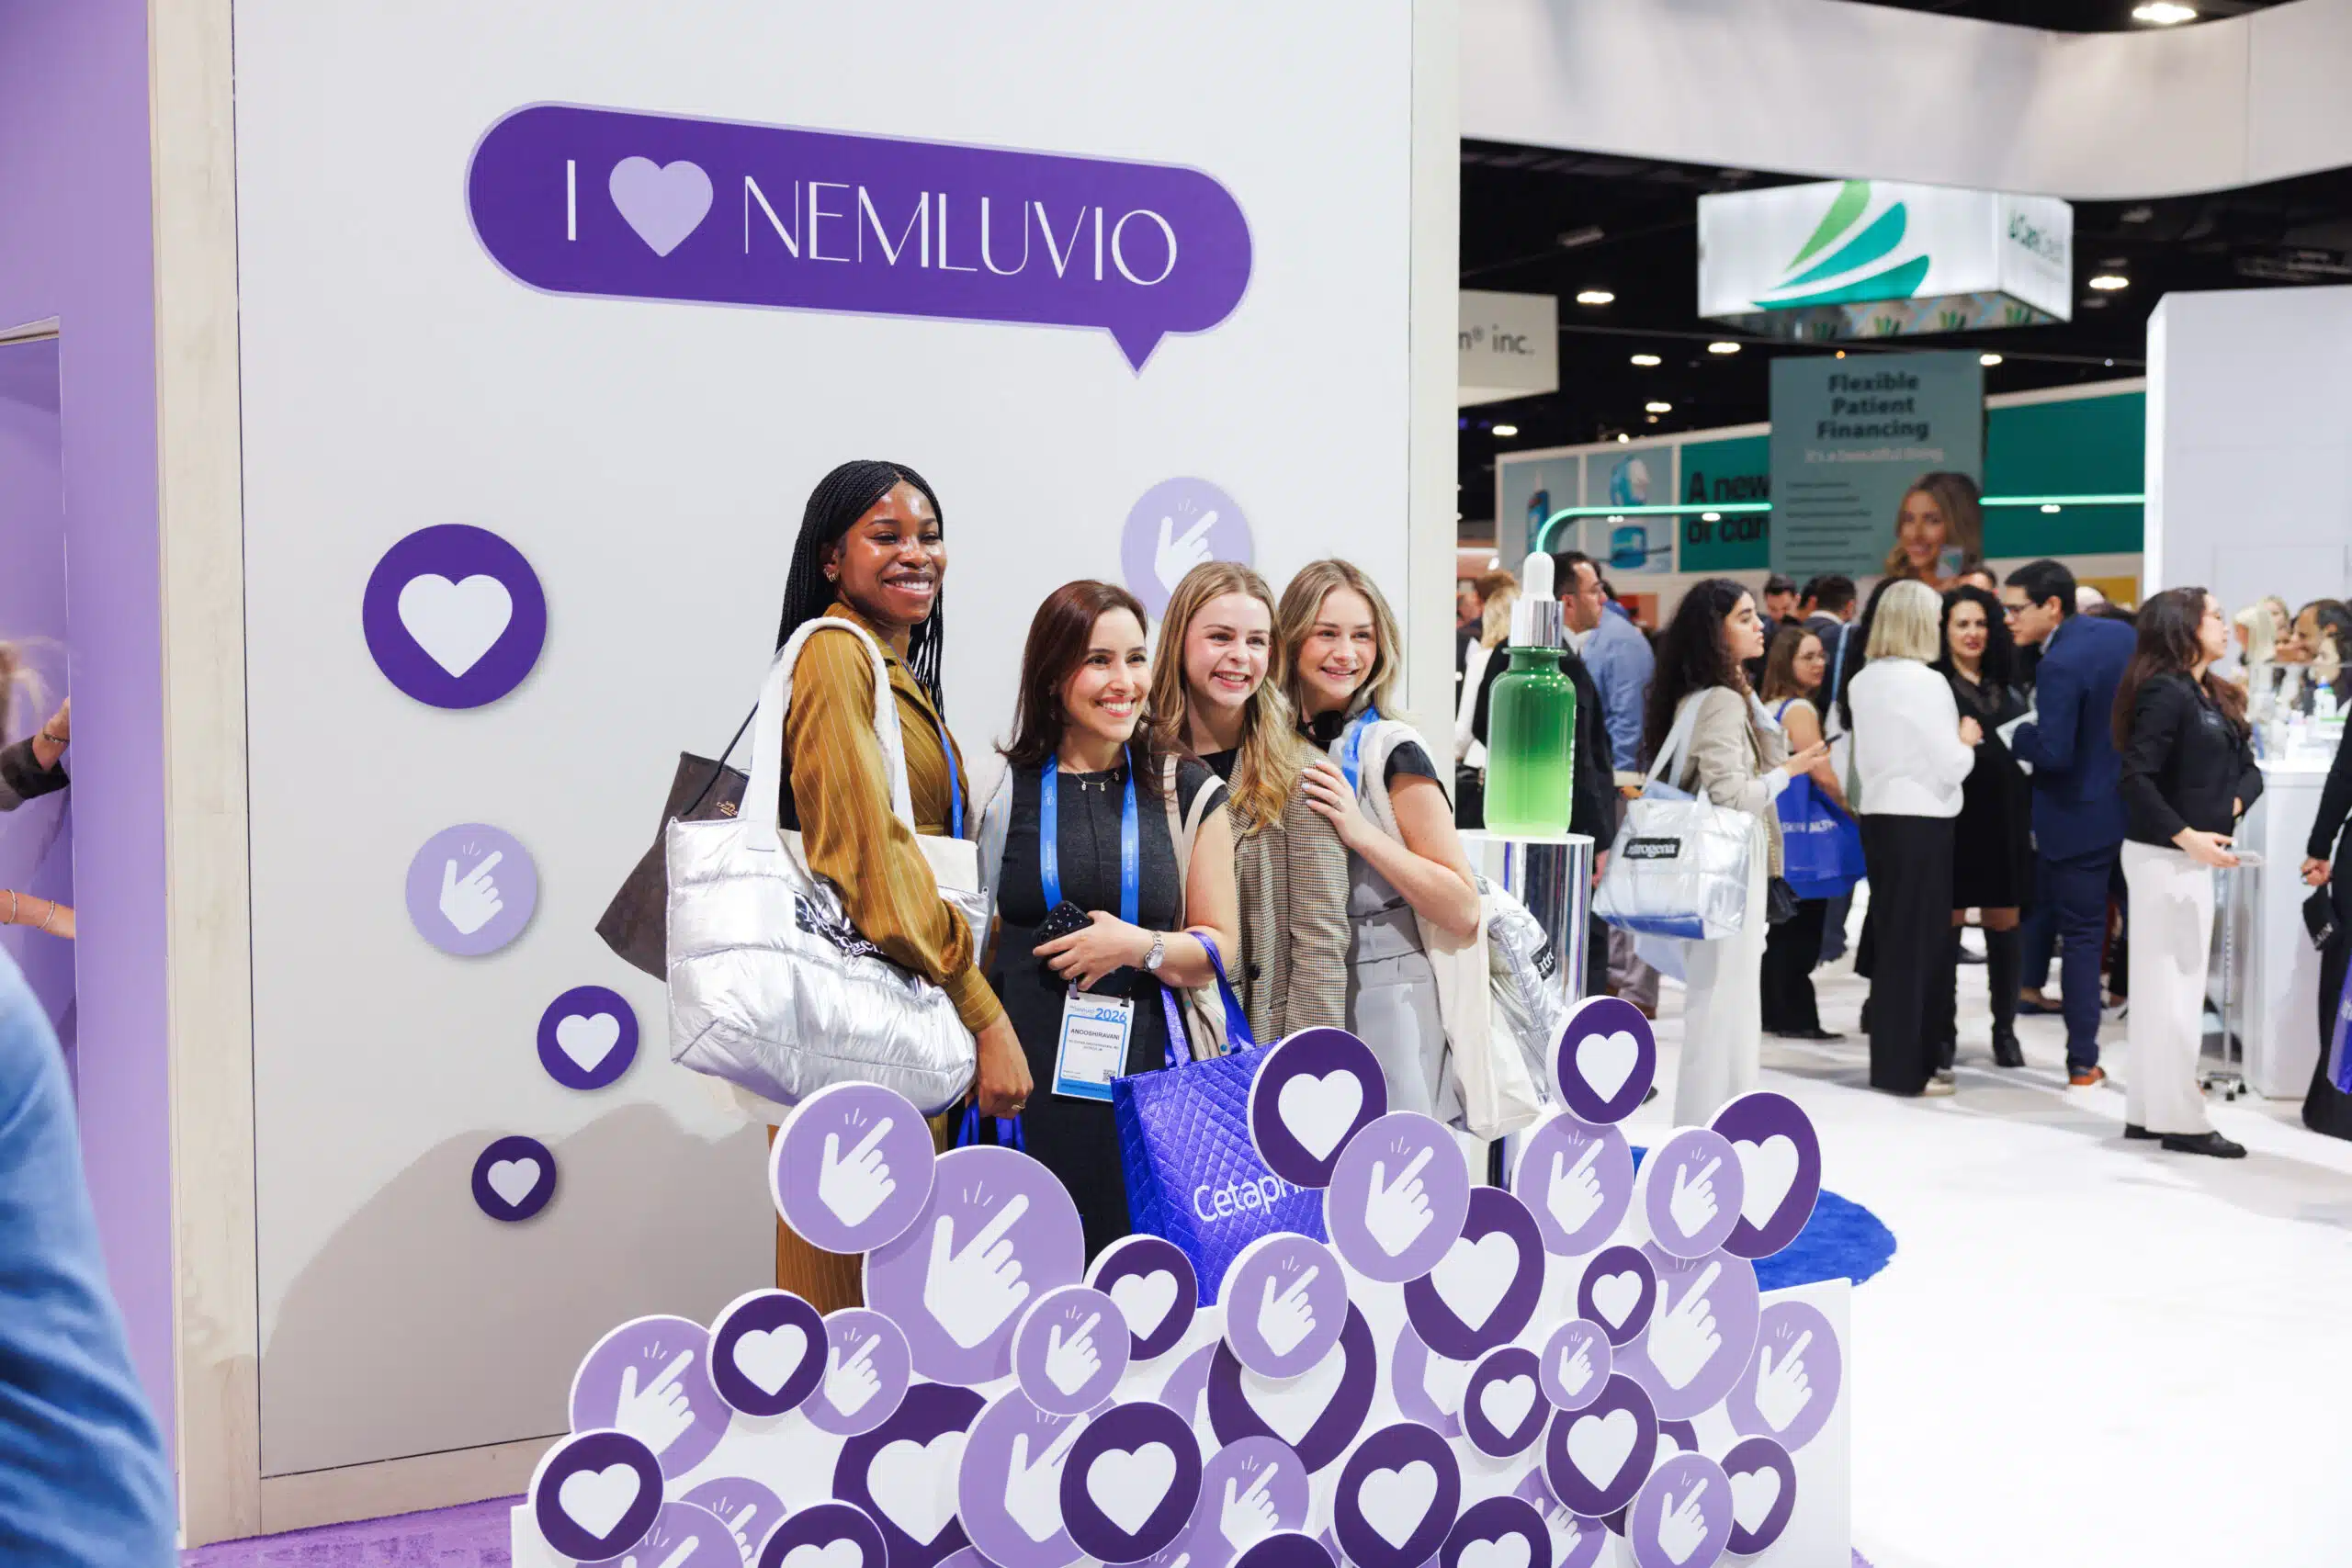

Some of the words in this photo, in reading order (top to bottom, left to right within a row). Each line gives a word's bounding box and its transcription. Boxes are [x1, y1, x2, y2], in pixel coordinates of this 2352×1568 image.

[566, 159, 577, 241] I
[744, 175, 1177, 286] NEMLUVIO
[1491, 322, 1535, 356] inc.
[1828, 371, 1919, 393] Flexible
[1831, 394, 1915, 415] Patient
[1816, 418, 1930, 442] Financing
[1687, 471, 1708, 503] A
[1713, 475, 1770, 502] new
[1095, 1008, 1127, 1023] 2026
[1070, 1028, 1120, 1040] ANOOSHIRAVANI
